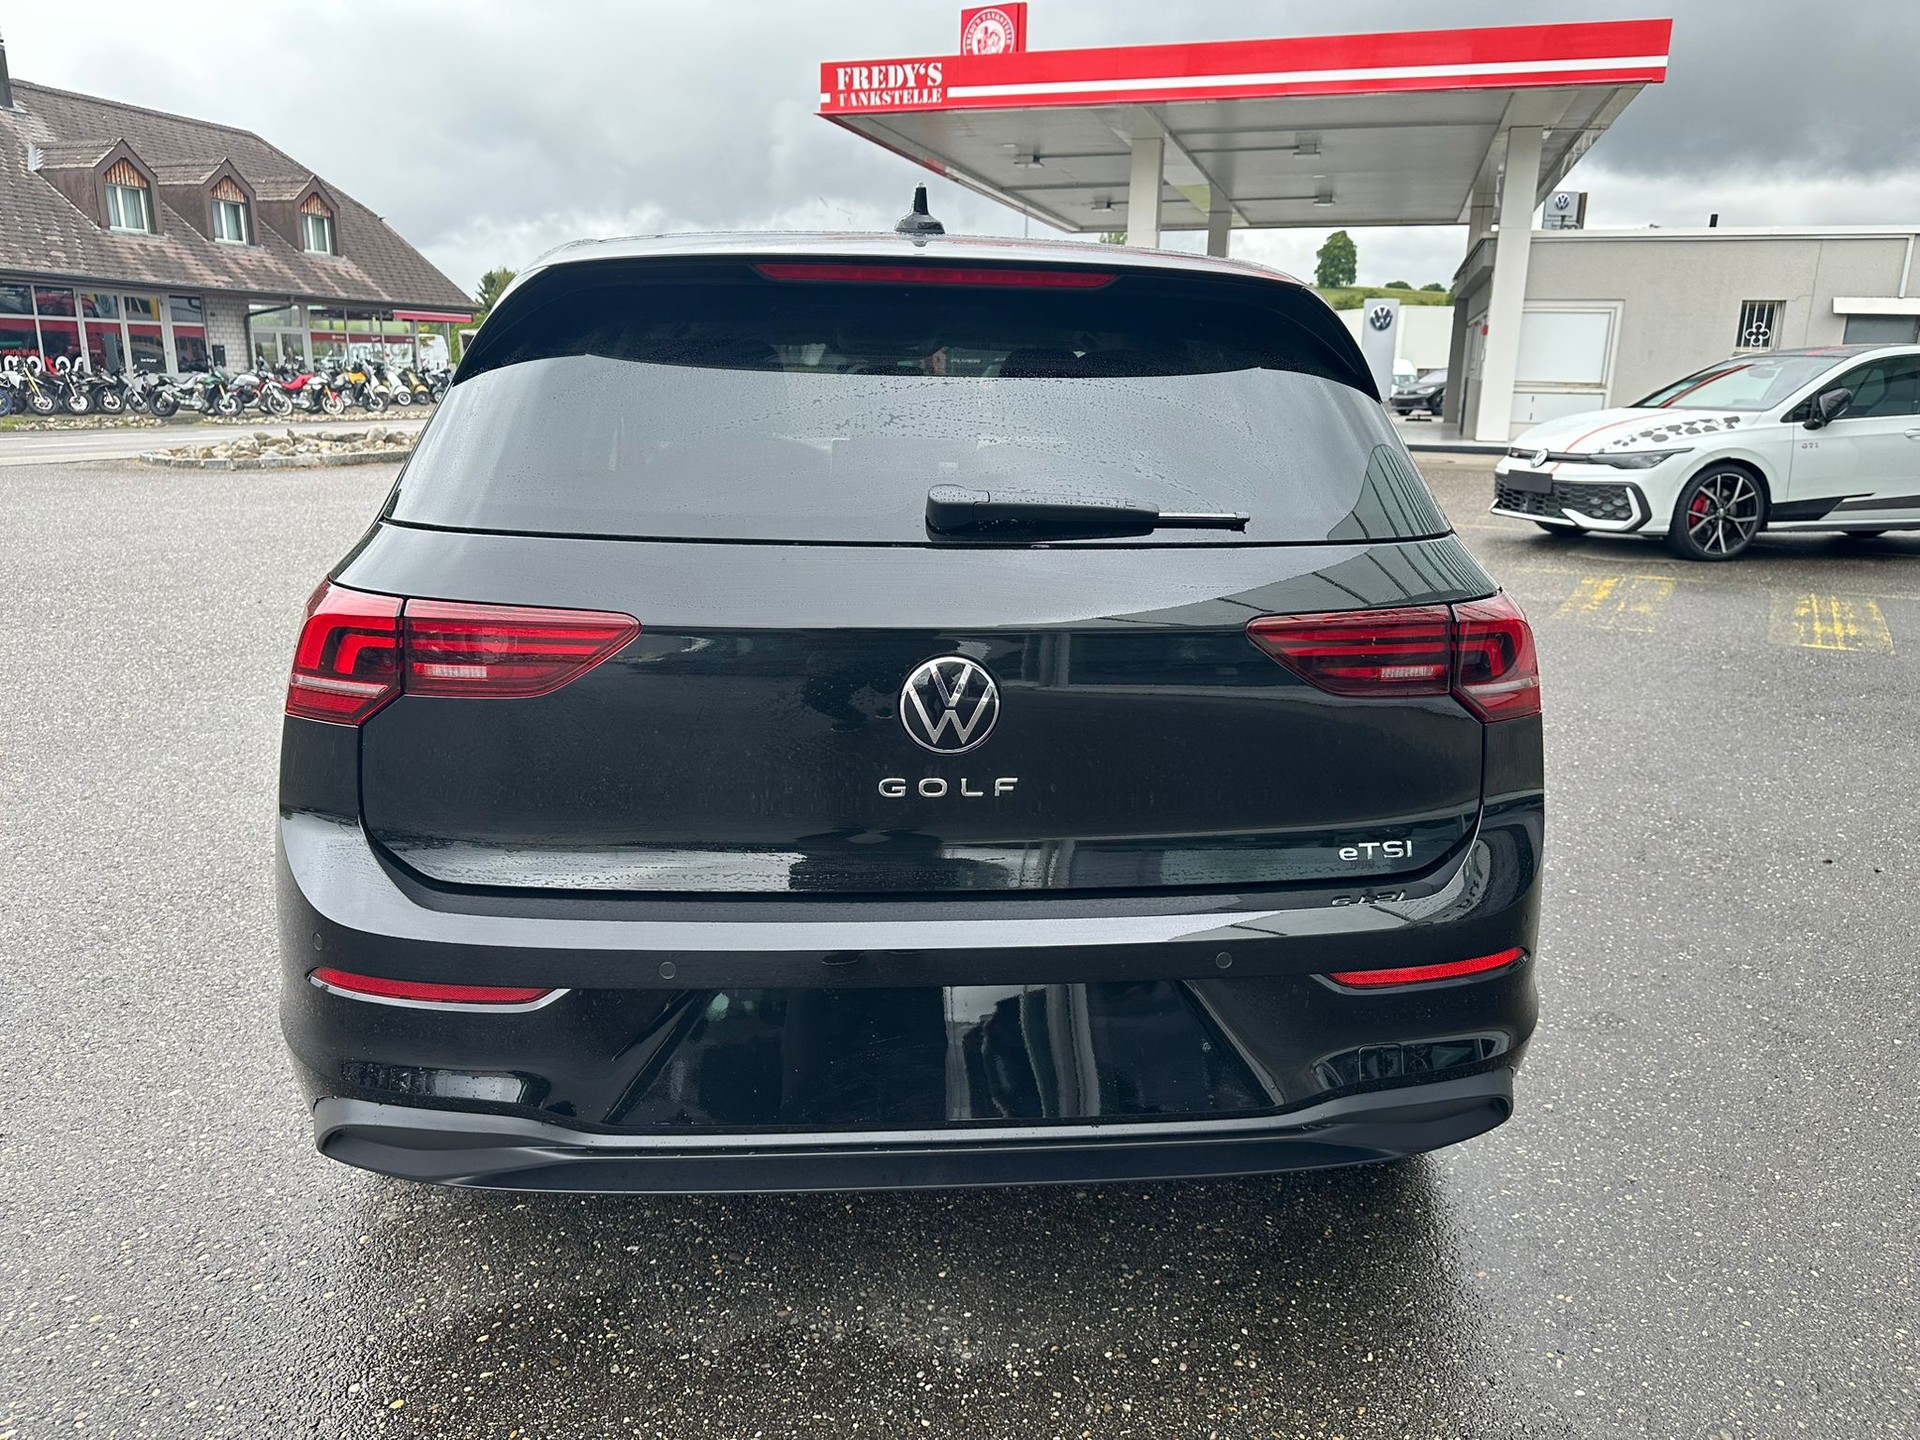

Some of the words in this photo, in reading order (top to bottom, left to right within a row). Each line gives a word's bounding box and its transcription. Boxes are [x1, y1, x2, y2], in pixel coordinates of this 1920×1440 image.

[836, 62, 943, 91] FREDY'S
[837, 87, 942, 107] TANKSTELLE
[1370, 305, 1393, 331] VW
[900, 655, 1000, 754] VW
[878, 777, 1018, 797] GOLF
[1338, 840, 1413, 861] eTSI
